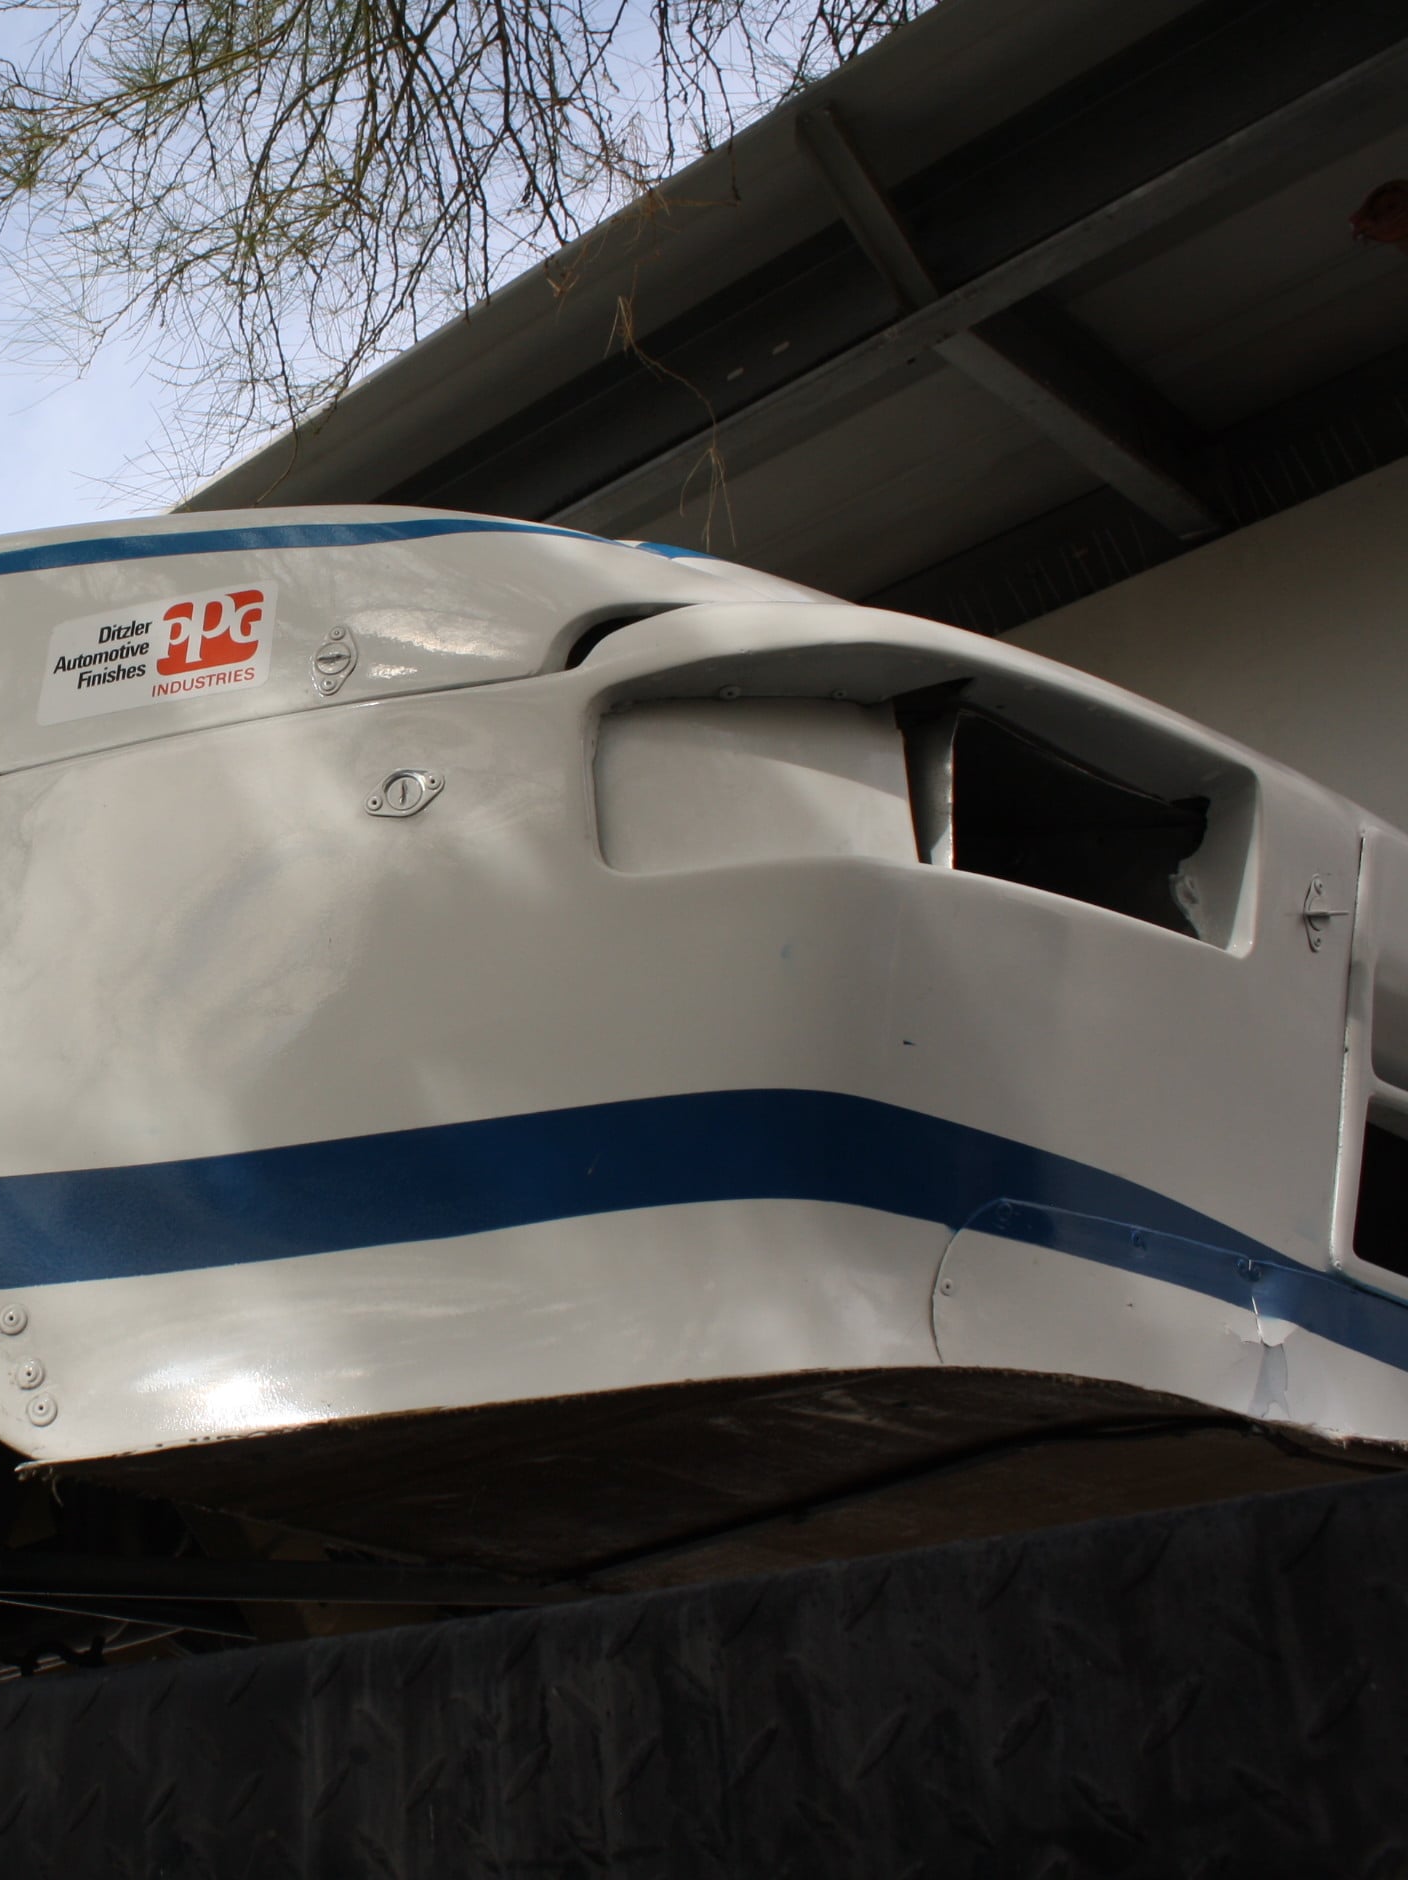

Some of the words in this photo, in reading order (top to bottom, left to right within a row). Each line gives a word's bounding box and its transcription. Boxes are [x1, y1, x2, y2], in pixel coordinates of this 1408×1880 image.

[98, 620, 152, 644] Ditzler
[157, 590, 265, 675] PPG
[53, 641, 149, 674] Automotive
[77, 664, 146, 690] Finishes
[151, 667, 255, 697] INDUSTRIES
